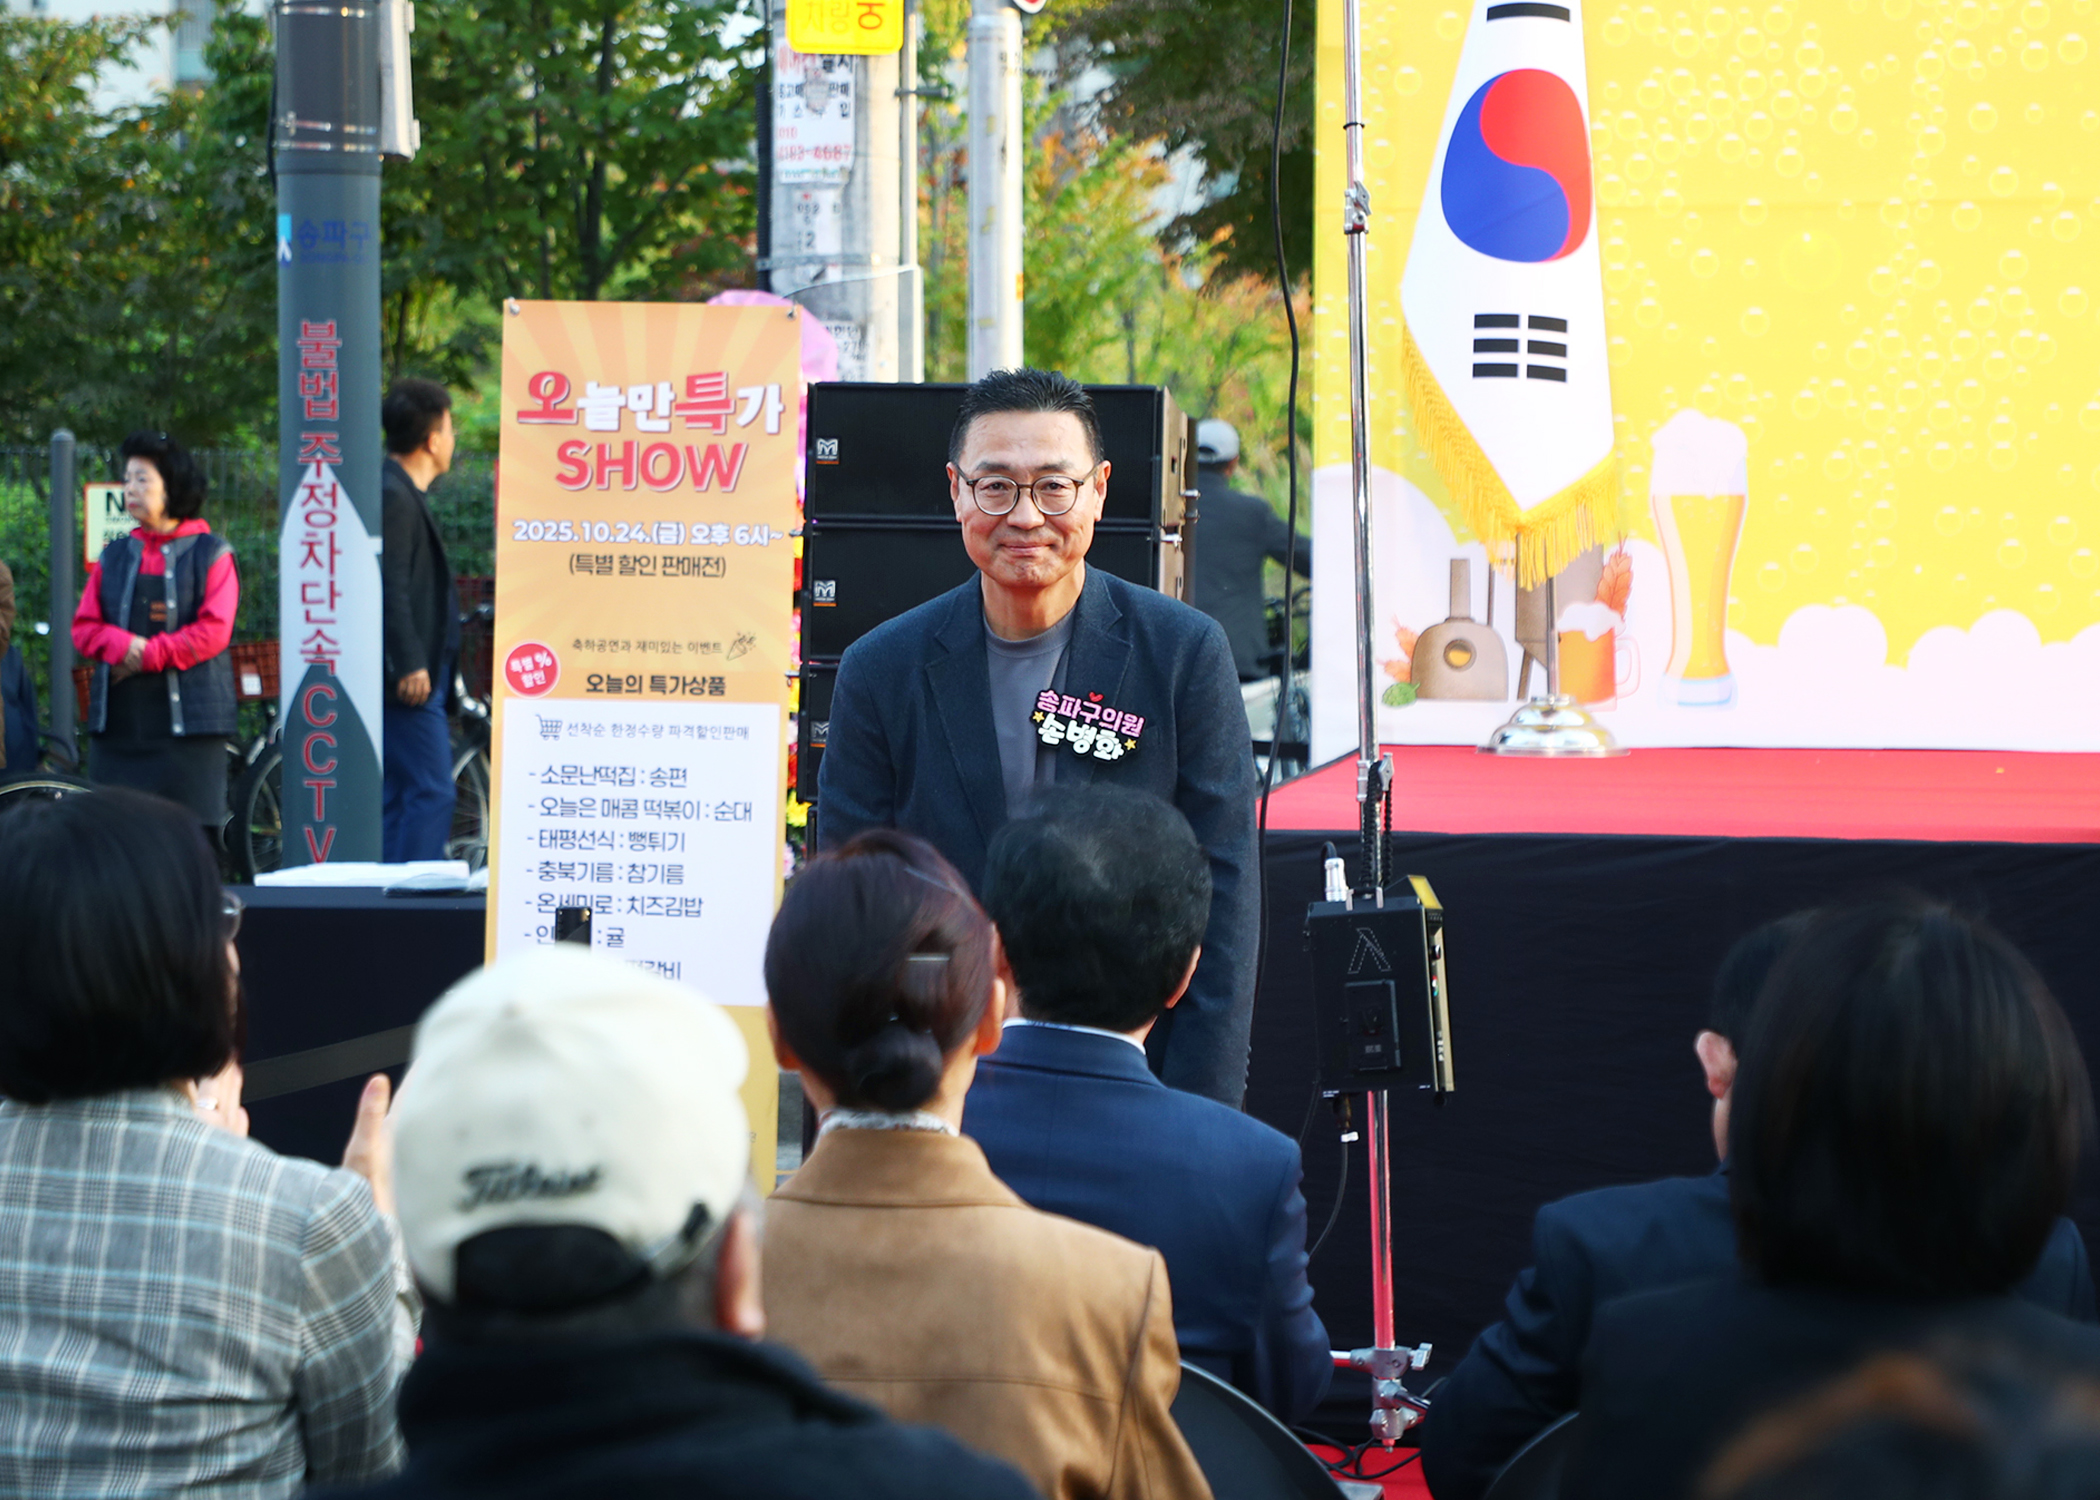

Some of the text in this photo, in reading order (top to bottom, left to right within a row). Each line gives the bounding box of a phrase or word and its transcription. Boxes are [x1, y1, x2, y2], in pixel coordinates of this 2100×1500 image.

[298, 320, 342, 421] 불법
[555, 440, 748, 493] SHOW
[690, 523, 730, 546] 오후
[733, 525, 784, 546] 6시~
[569, 554, 727, 579] (특별 할인 판매전)
[687, 641, 723, 655] 이벤트
[586, 674, 727, 696] 오늘의 특가상품
[1037, 689, 1145, 738] 송파구의원
[1038, 712, 1124, 761] 손병화
[541, 765, 636, 786] 소문난떡집
[650, 766, 687, 788] 송편
[540, 797, 597, 818] 오늘은
[601, 798, 639, 819] 매콤
[644, 799, 700, 821] 떡볶이
[714, 800, 752, 822] 순대
[539, 829, 615, 850] 태평선식
[628, 831, 685, 852] 뻥튀기
[538, 861, 614, 882] 충북기름
[627, 863, 684, 885] 참기름
[626, 895, 703, 917] 치즈김밥
[606, 927, 625, 947] 귤
